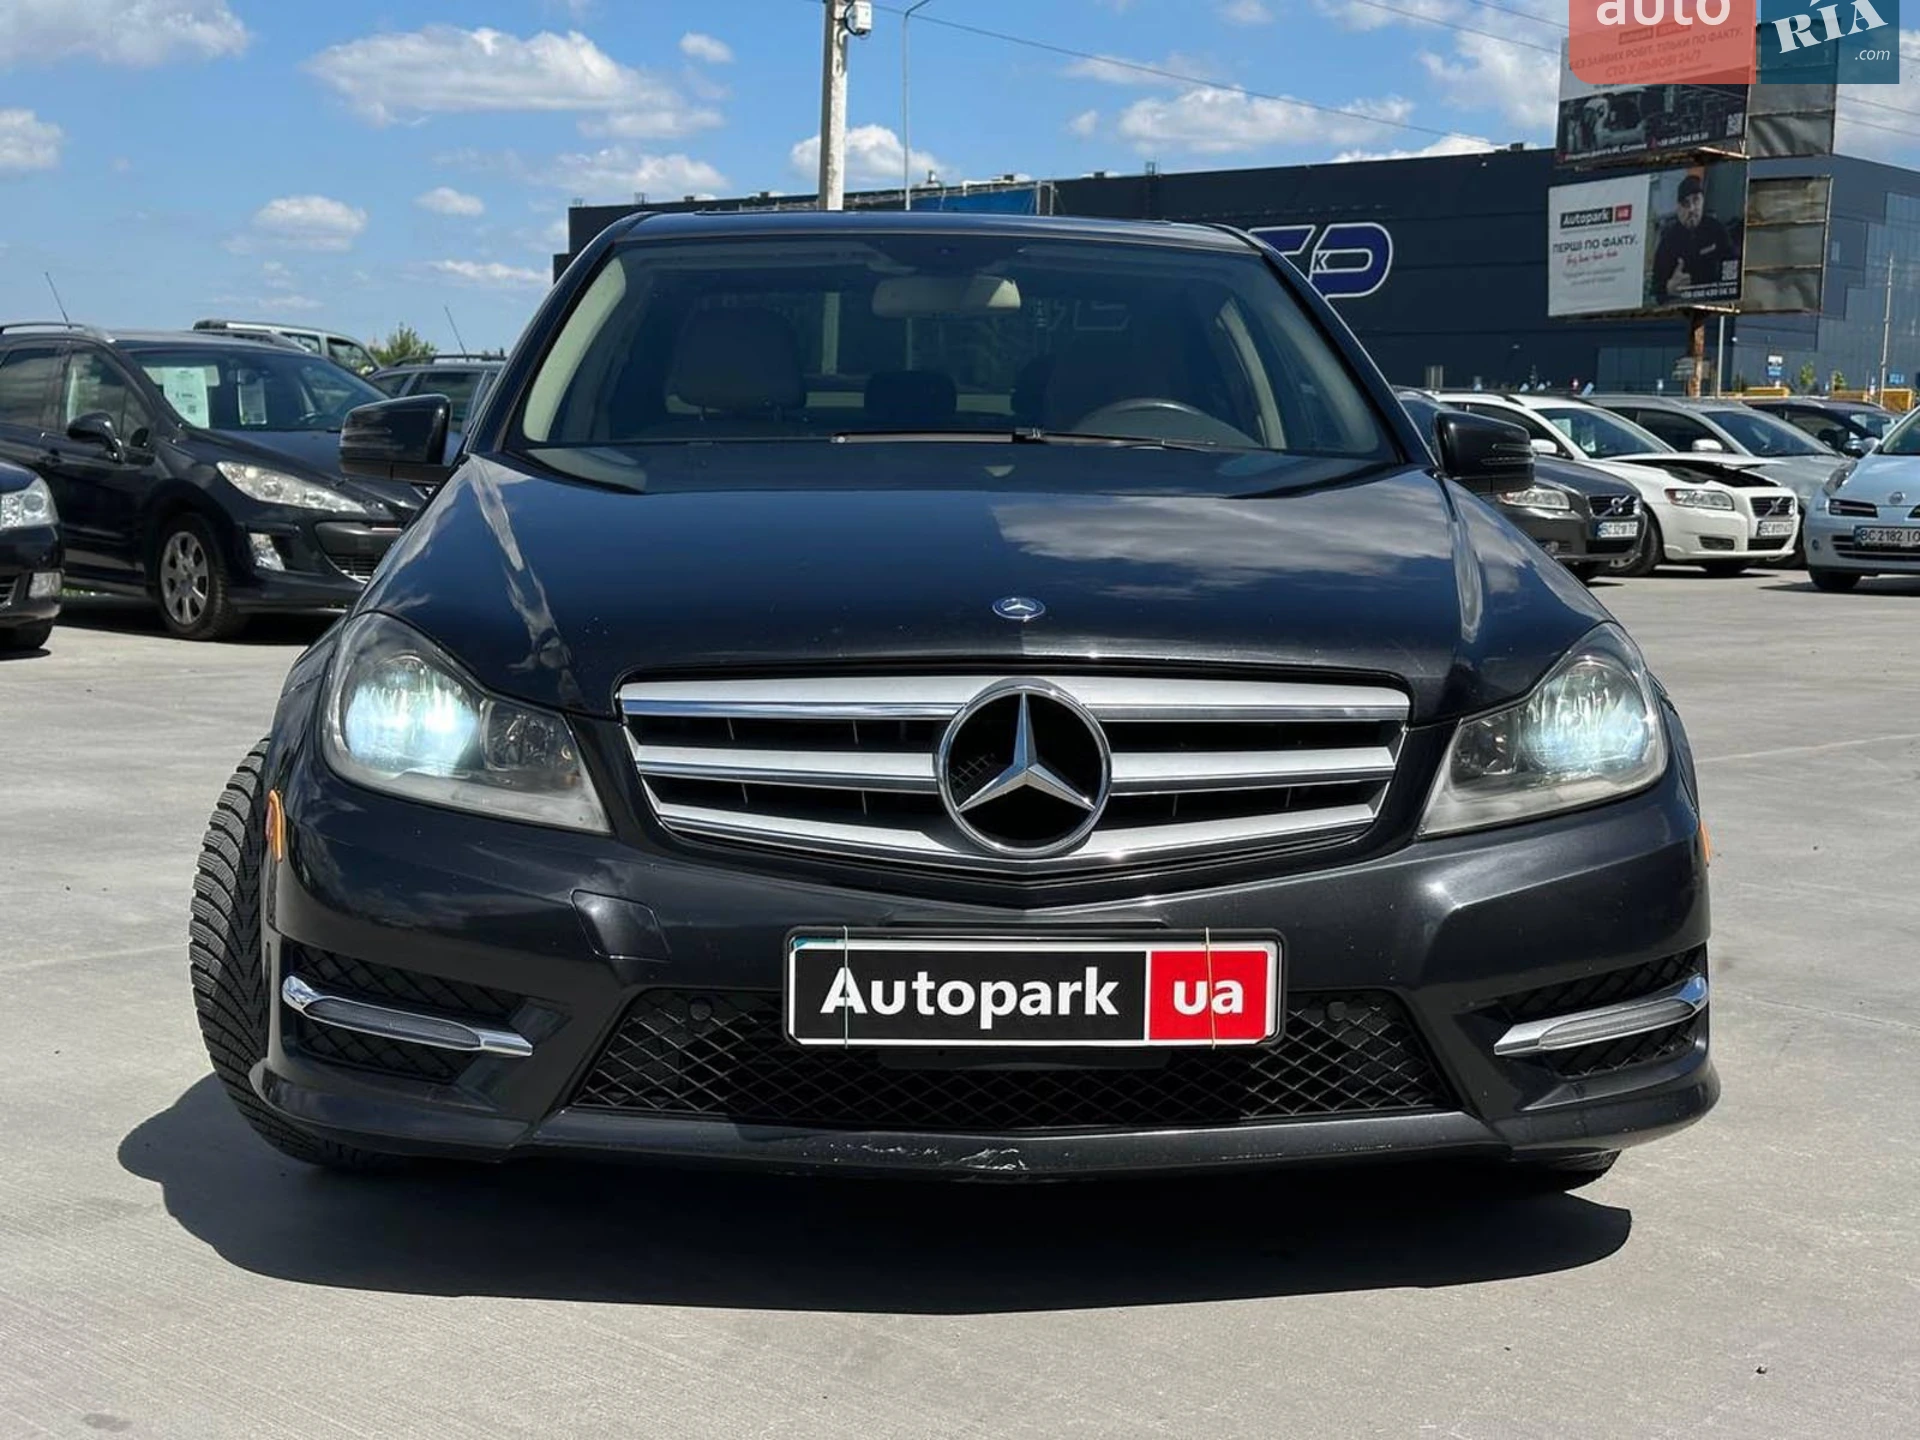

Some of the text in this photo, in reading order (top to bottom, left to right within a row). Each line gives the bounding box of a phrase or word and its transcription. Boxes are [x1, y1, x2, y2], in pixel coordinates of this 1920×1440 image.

[1562, 209, 1610, 226] Autopark
[1585, 239, 1600, 250] ПО
[1602, 234, 1638, 248] ФАКТУ.
[1860, 529, 1876, 541] BC
[1877, 530, 1903, 542] 2182
[820, 966, 1244, 1030] Autopark ua
